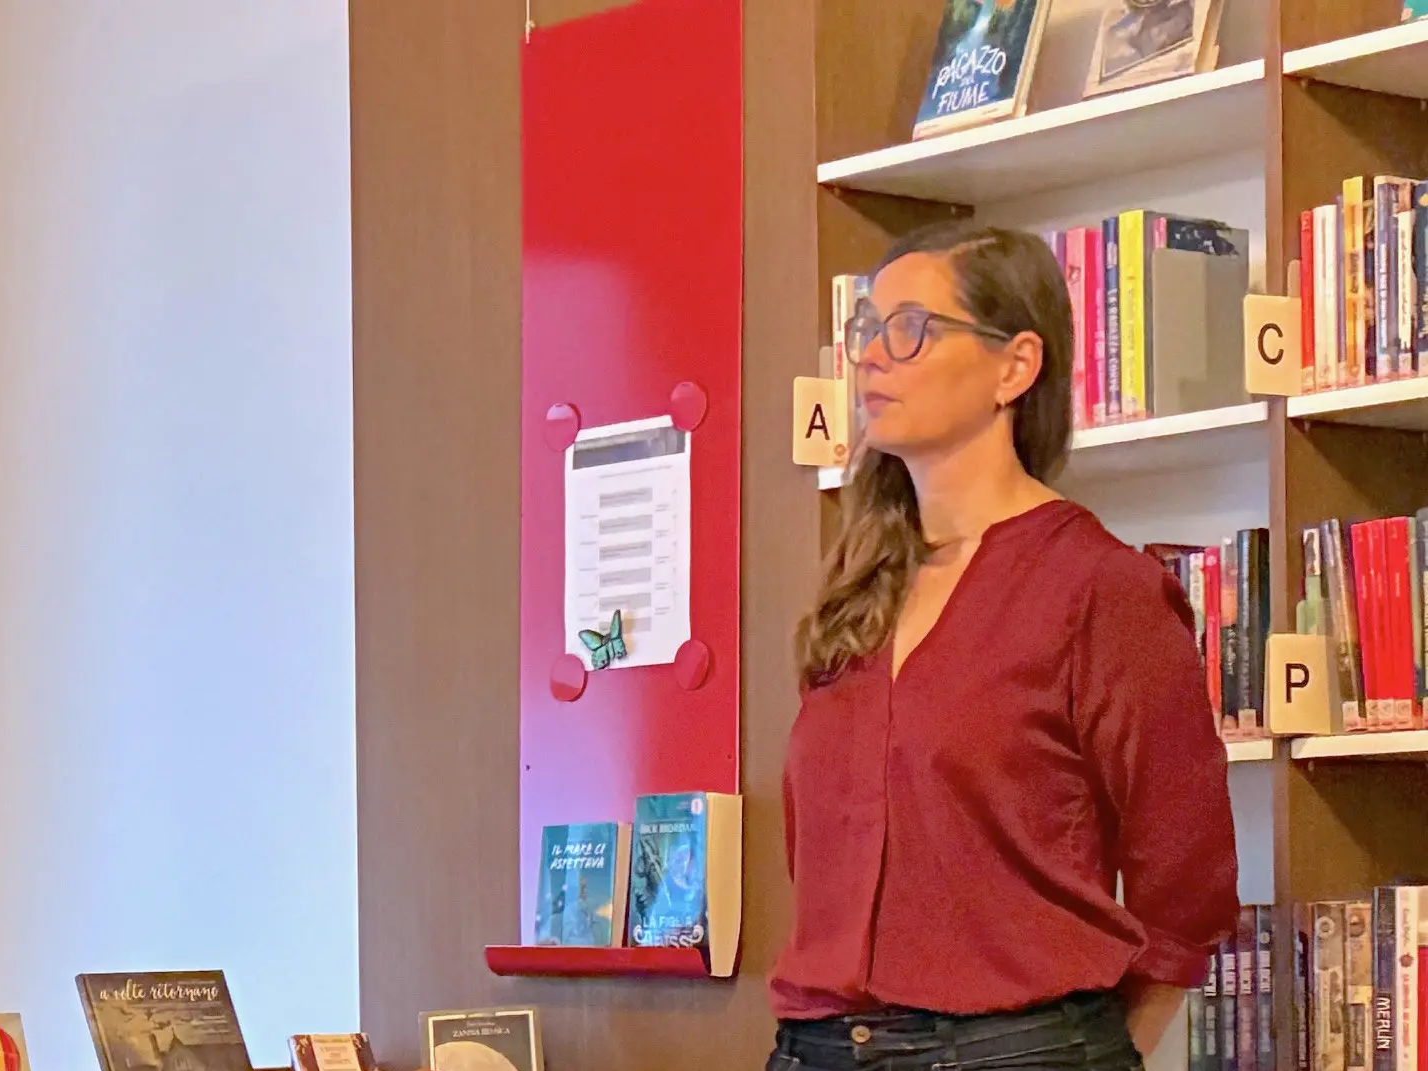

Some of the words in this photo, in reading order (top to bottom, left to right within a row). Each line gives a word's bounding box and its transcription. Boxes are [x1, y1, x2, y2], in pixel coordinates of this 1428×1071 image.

[937, 81, 990, 114] FIUME
[1257, 323, 1284, 365] C
[805, 403, 830, 441] A
[1285, 663, 1310, 704] P
[100, 991, 110, 1001] a
[113, 978, 145, 1001] volte
[148, 983, 219, 1002] ritornano
[1376, 996, 1394, 1050] MERLIN
